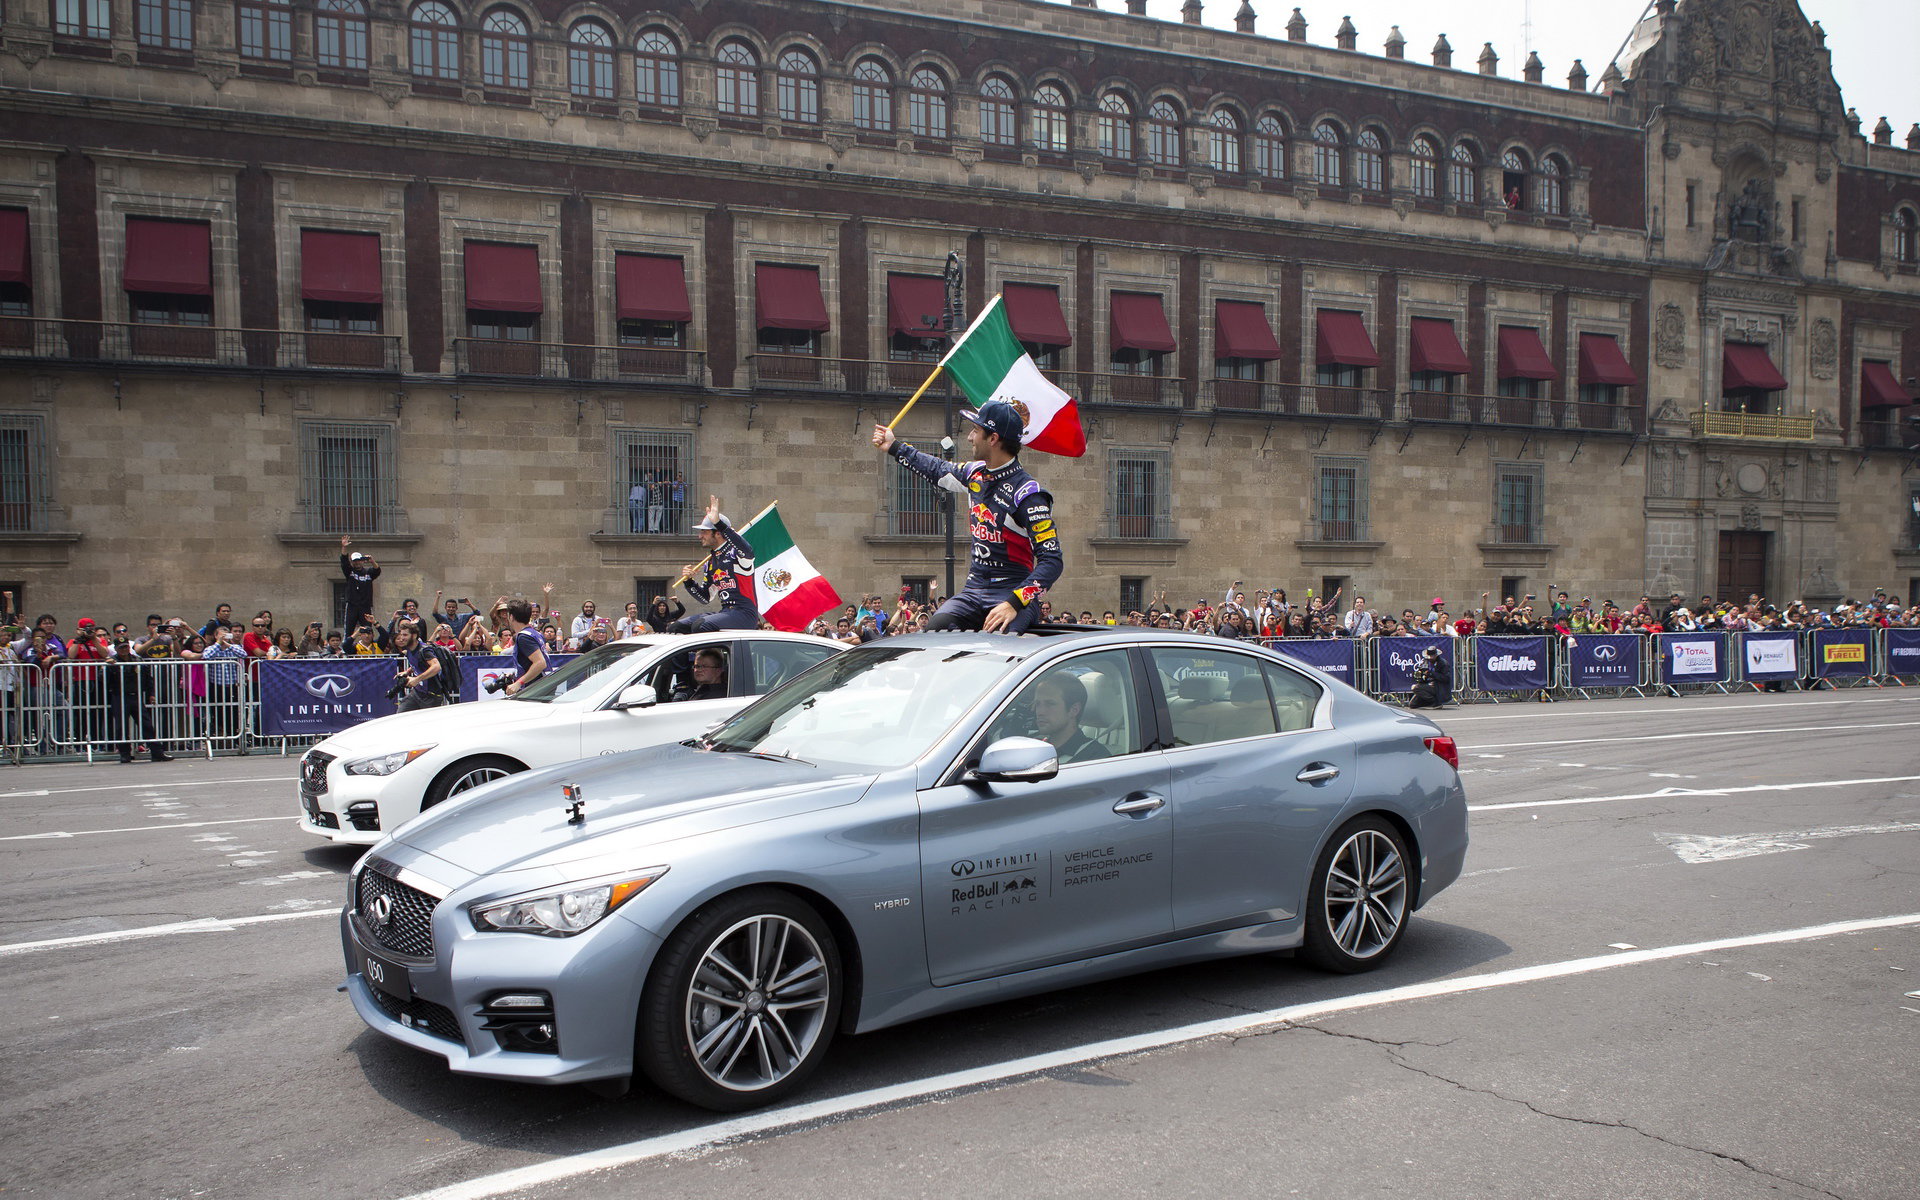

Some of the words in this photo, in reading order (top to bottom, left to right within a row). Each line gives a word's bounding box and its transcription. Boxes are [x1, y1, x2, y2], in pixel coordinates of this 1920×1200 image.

[1685, 647, 1708, 655] TOTAL
[1828, 648, 1861, 659] PIRELLI
[1390, 651, 1413, 671] Pepe
[1488, 655, 1536, 672] Gillette
[1584, 665, 1627, 673] INFINITI
[289, 703, 372, 715] INFINITI
[979, 852, 1037, 870] INFINITI
[1064, 847, 1115, 863] VEHICLE
[1064, 852, 1153, 875] PERFORMANCE
[1064, 870, 1120, 887] PARTNER
[874, 897, 911, 911] HYBRID
[951, 893, 1037, 916] RACING
[367, 957, 384, 983] Q50
